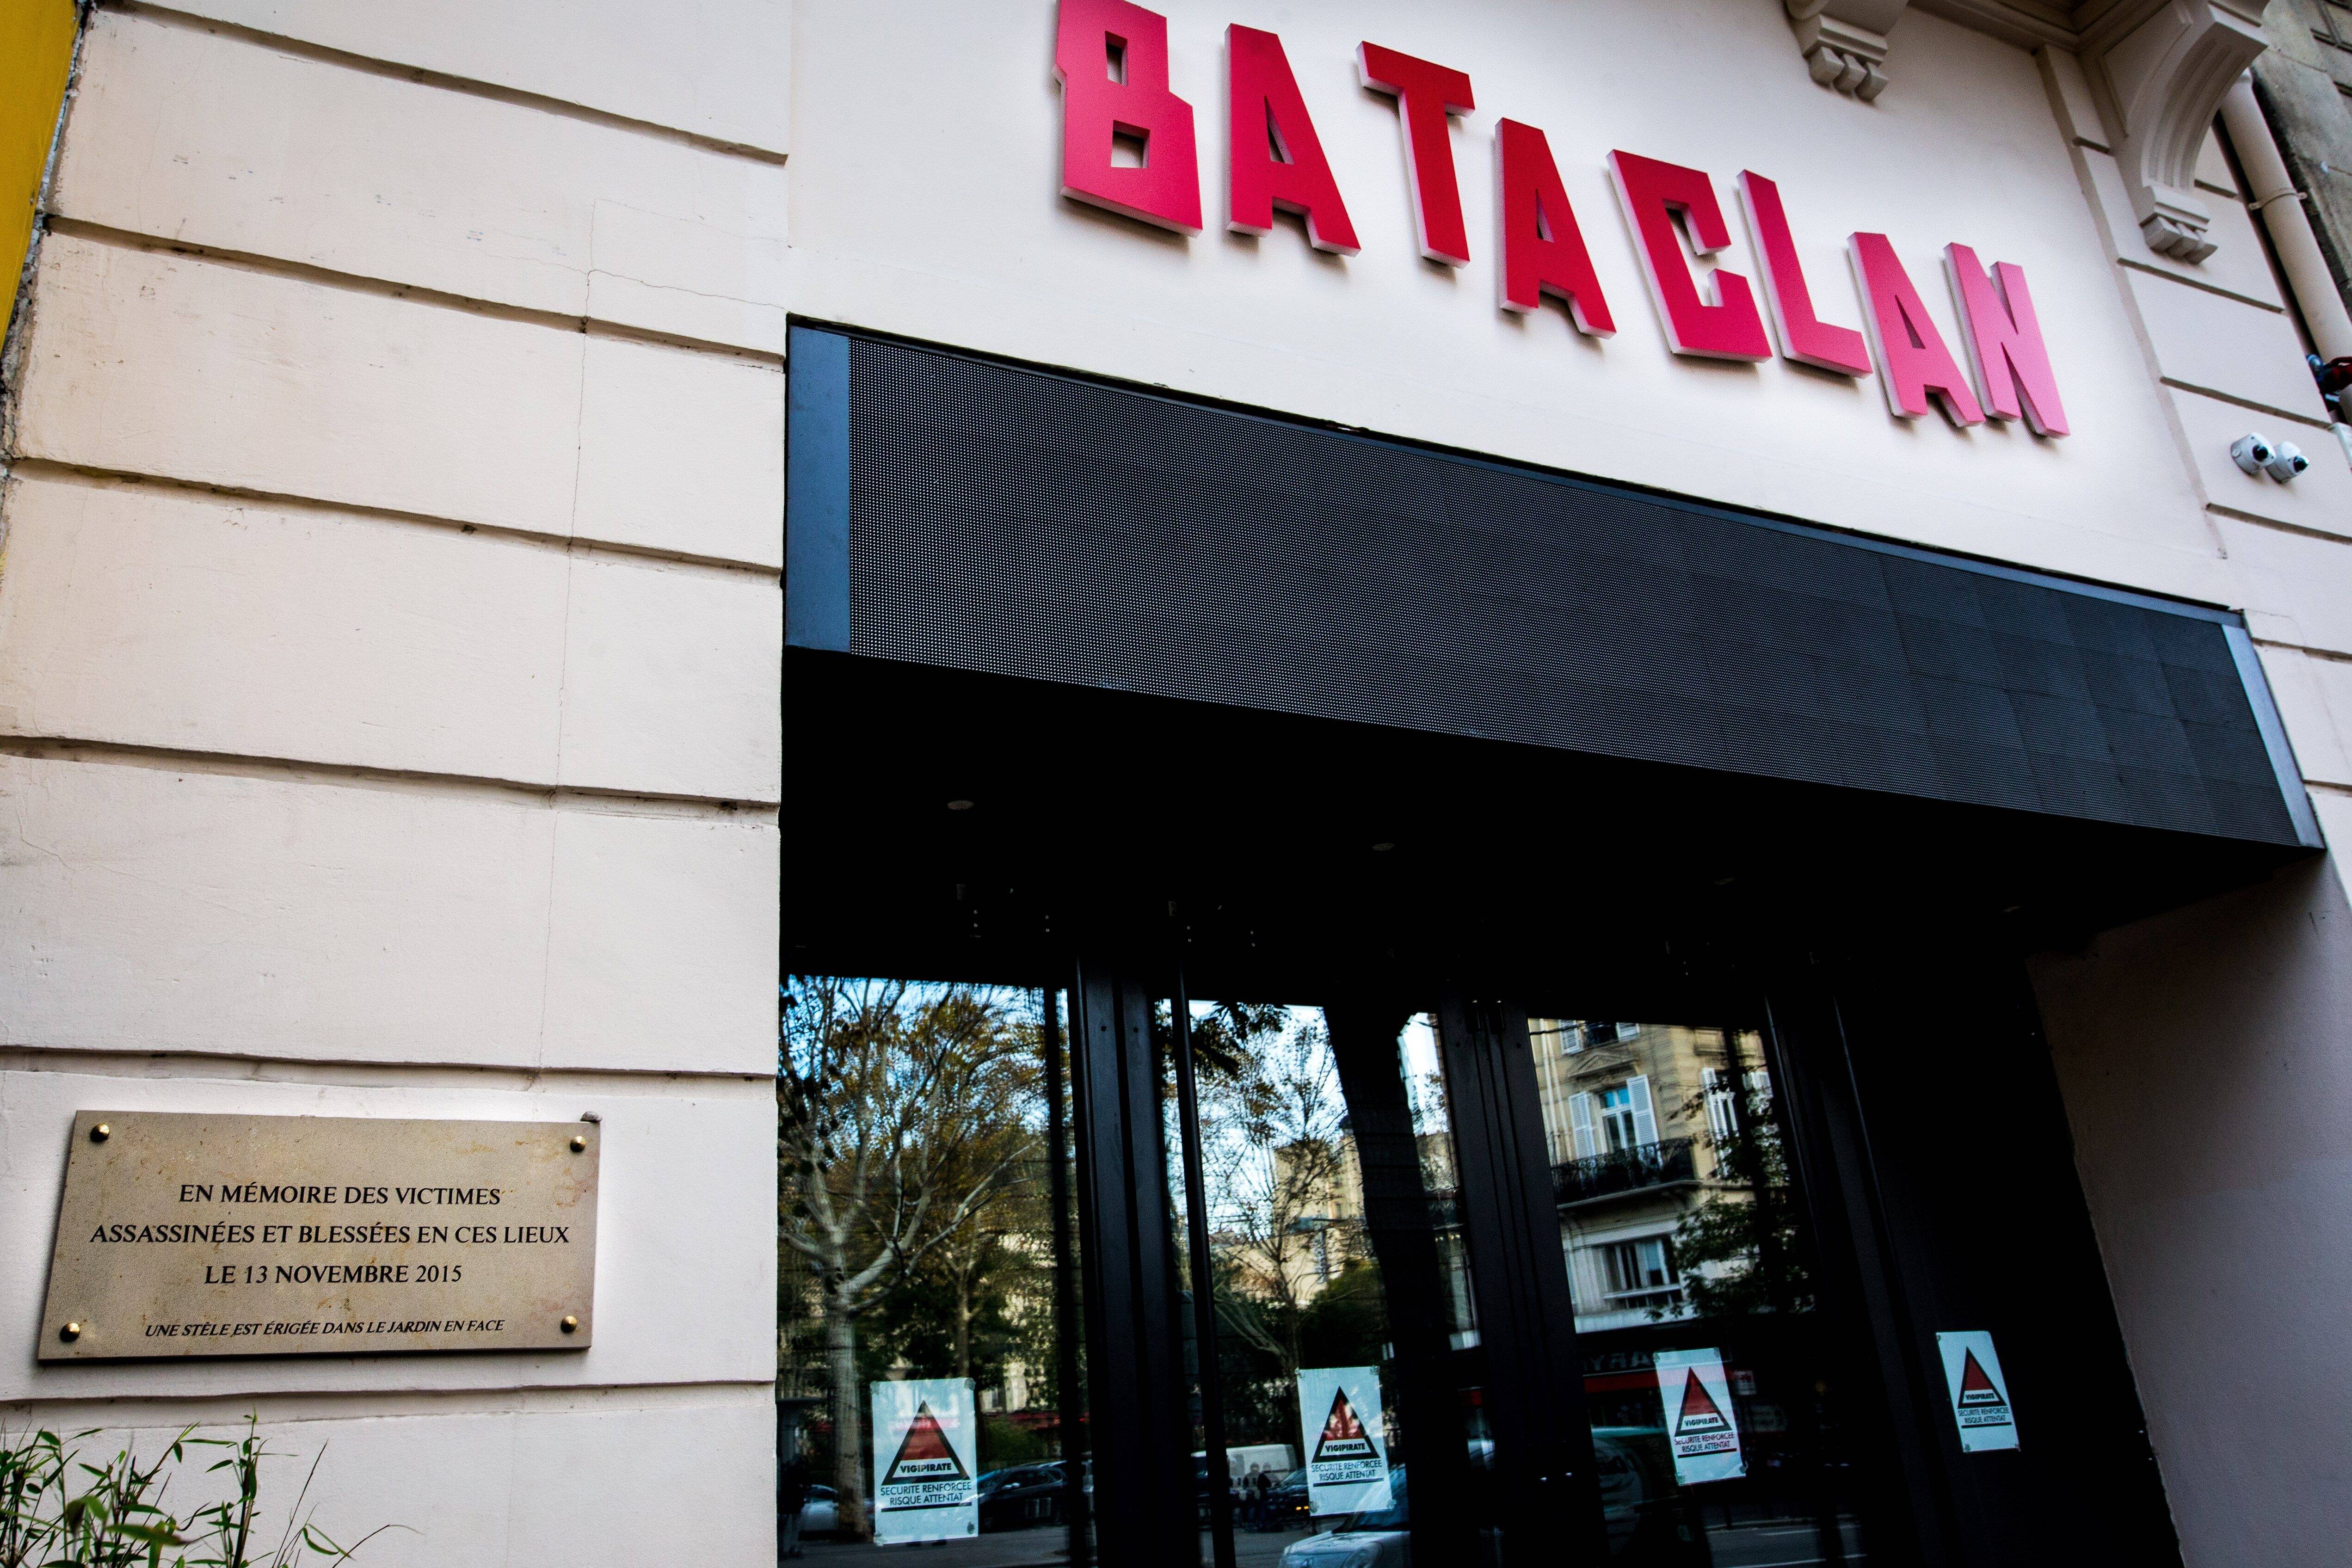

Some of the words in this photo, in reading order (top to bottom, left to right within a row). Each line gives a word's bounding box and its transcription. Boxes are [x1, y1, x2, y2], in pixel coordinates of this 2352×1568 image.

[1053, 0, 2070, 438] BATACLAN
[178, 1184, 215, 1203] EN
[220, 1181, 338, 1204] MÉMOIRE
[343, 1186, 389, 1205] DES
[394, 1187, 501, 1205] VICTIMES
[88, 1220, 255, 1244] ASSASSINÉES
[261, 1224, 294, 1244] ET
[297, 1221, 411, 1244] BLESSÉES
[416, 1225, 449, 1244] EN
[454, 1226, 498, 1244] CES
[503, 1226, 570, 1244] LIEUX
[203, 1265, 236, 1285] LE
[245, 1265, 268, 1285] 13
[274, 1265, 409, 1284] NOVEMBRE
[414, 1264, 462, 1283] 2015
[144, 1322, 181, 1338] UNE
[182, 1321, 231, 1337] STÈLE
[231, 1322, 263, 1336] EST
[263, 1320, 321, 1335] ÉRIGÉE
[321, 1322, 365, 1334] DANS
[366, 1321, 387, 1334] LE
[387, 1320, 443, 1334] JARDIN
[443, 1320, 465, 1333] EN
[466, 1319, 506, 1332] FACE
[1325, 1443, 1366, 1452] VIGIPIRATE
[900, 1463, 952, 1473] VIGIPIRATE
[1311, 1463, 1343, 1472] SECURITE
[1343, 1460, 1382, 1470] RENFORCEE
[1319, 1472, 1344, 1481] RISQUE
[1345, 1470, 1375, 1479] ATTENTAT
[880, 1485, 920, 1496] SECURITE
[923, 1482, 972, 1493] RENFORCEE
[890, 1495, 921, 1506] RISQUE
[923, 1493, 963, 1503] ATTENTAT
